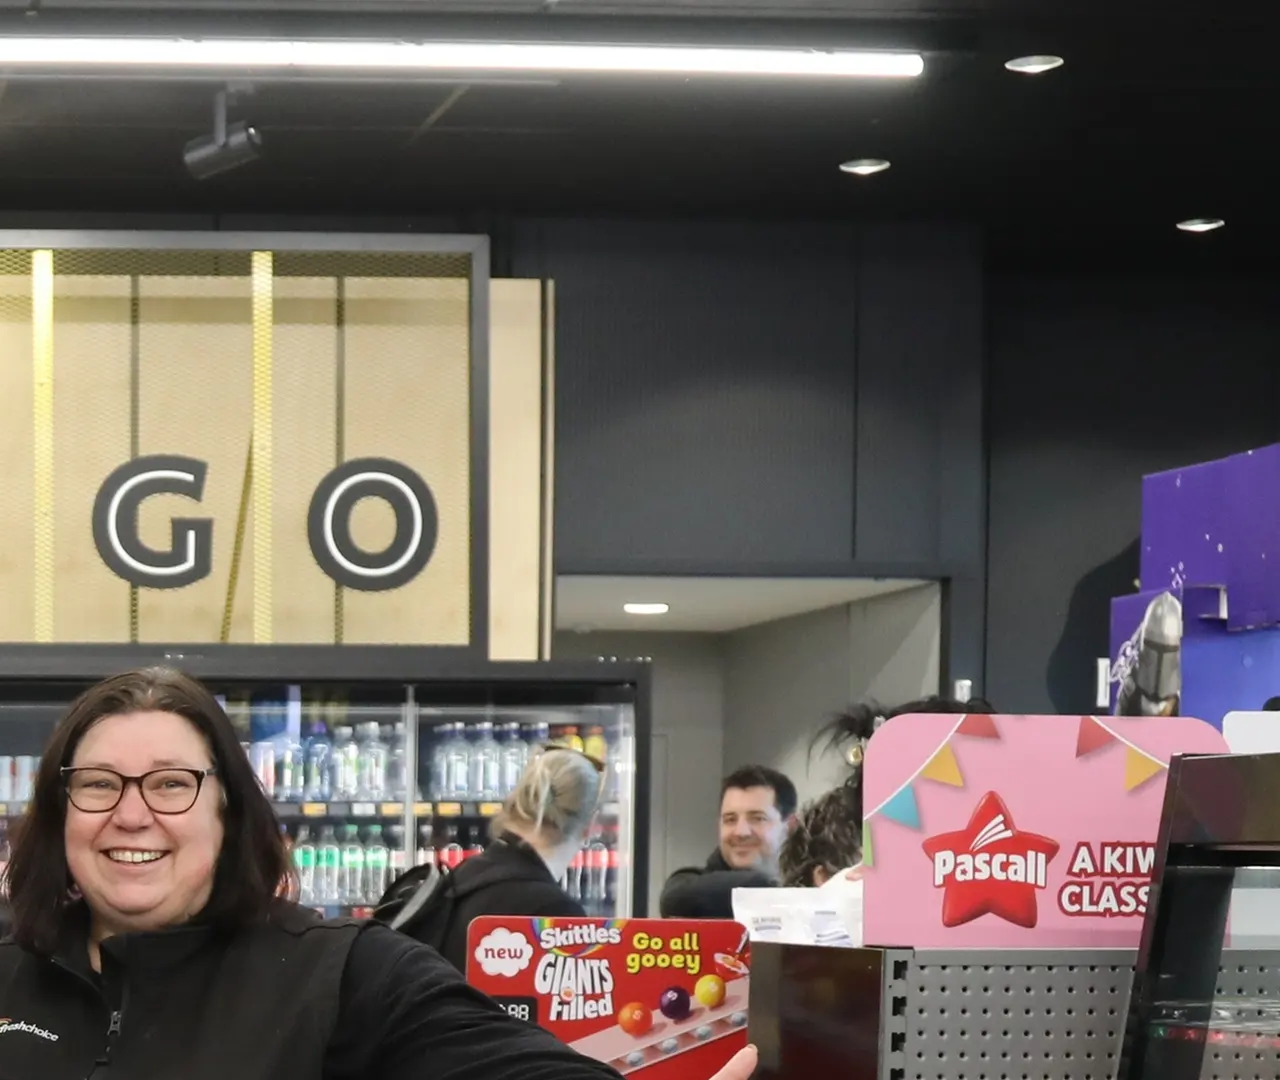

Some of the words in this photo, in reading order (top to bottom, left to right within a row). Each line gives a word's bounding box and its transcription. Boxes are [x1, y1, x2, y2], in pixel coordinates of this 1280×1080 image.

[93, 453, 439, 592] GO
[934, 850, 1047, 888] Pascall
[1071, 846, 1091, 873] A
[1103, 846, 1156, 873] KIW
[541, 924, 622, 949] Skittles
[632, 933, 663, 952] Go
[671, 932, 701, 951] all
[483, 944, 524, 961] new
[626, 951, 702, 976] gooey
[535, 953, 615, 995] GIANTS
[549, 994, 614, 1022] Filled
[0, 1020, 60, 1042] freshchoice
